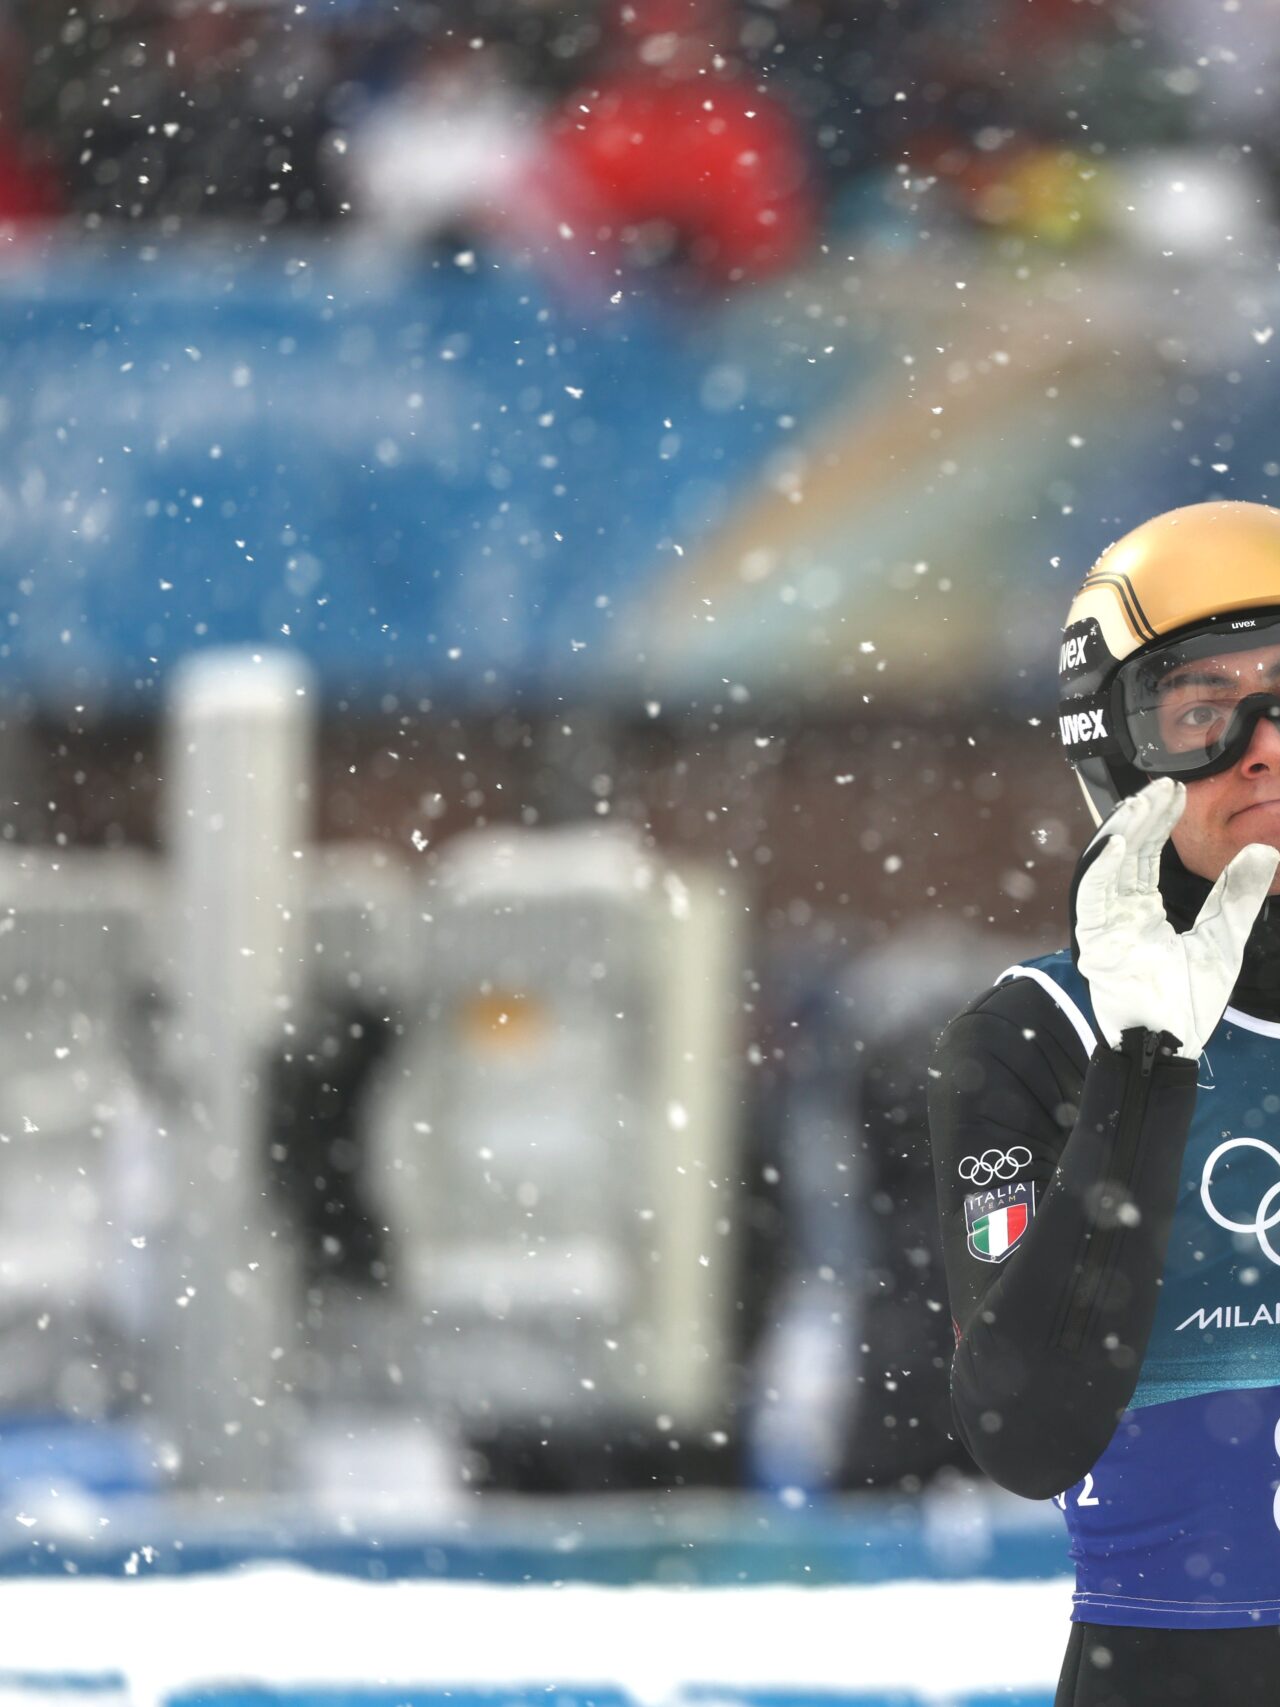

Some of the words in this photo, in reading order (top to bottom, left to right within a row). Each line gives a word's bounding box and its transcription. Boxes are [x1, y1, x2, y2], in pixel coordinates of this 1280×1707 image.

[1231, 620, 1256, 629] uvex
[1059, 709, 1108, 745] uvex
[970, 1182, 1026, 1211] ITALIA
[979, 1195, 1016, 1213] TEAM
